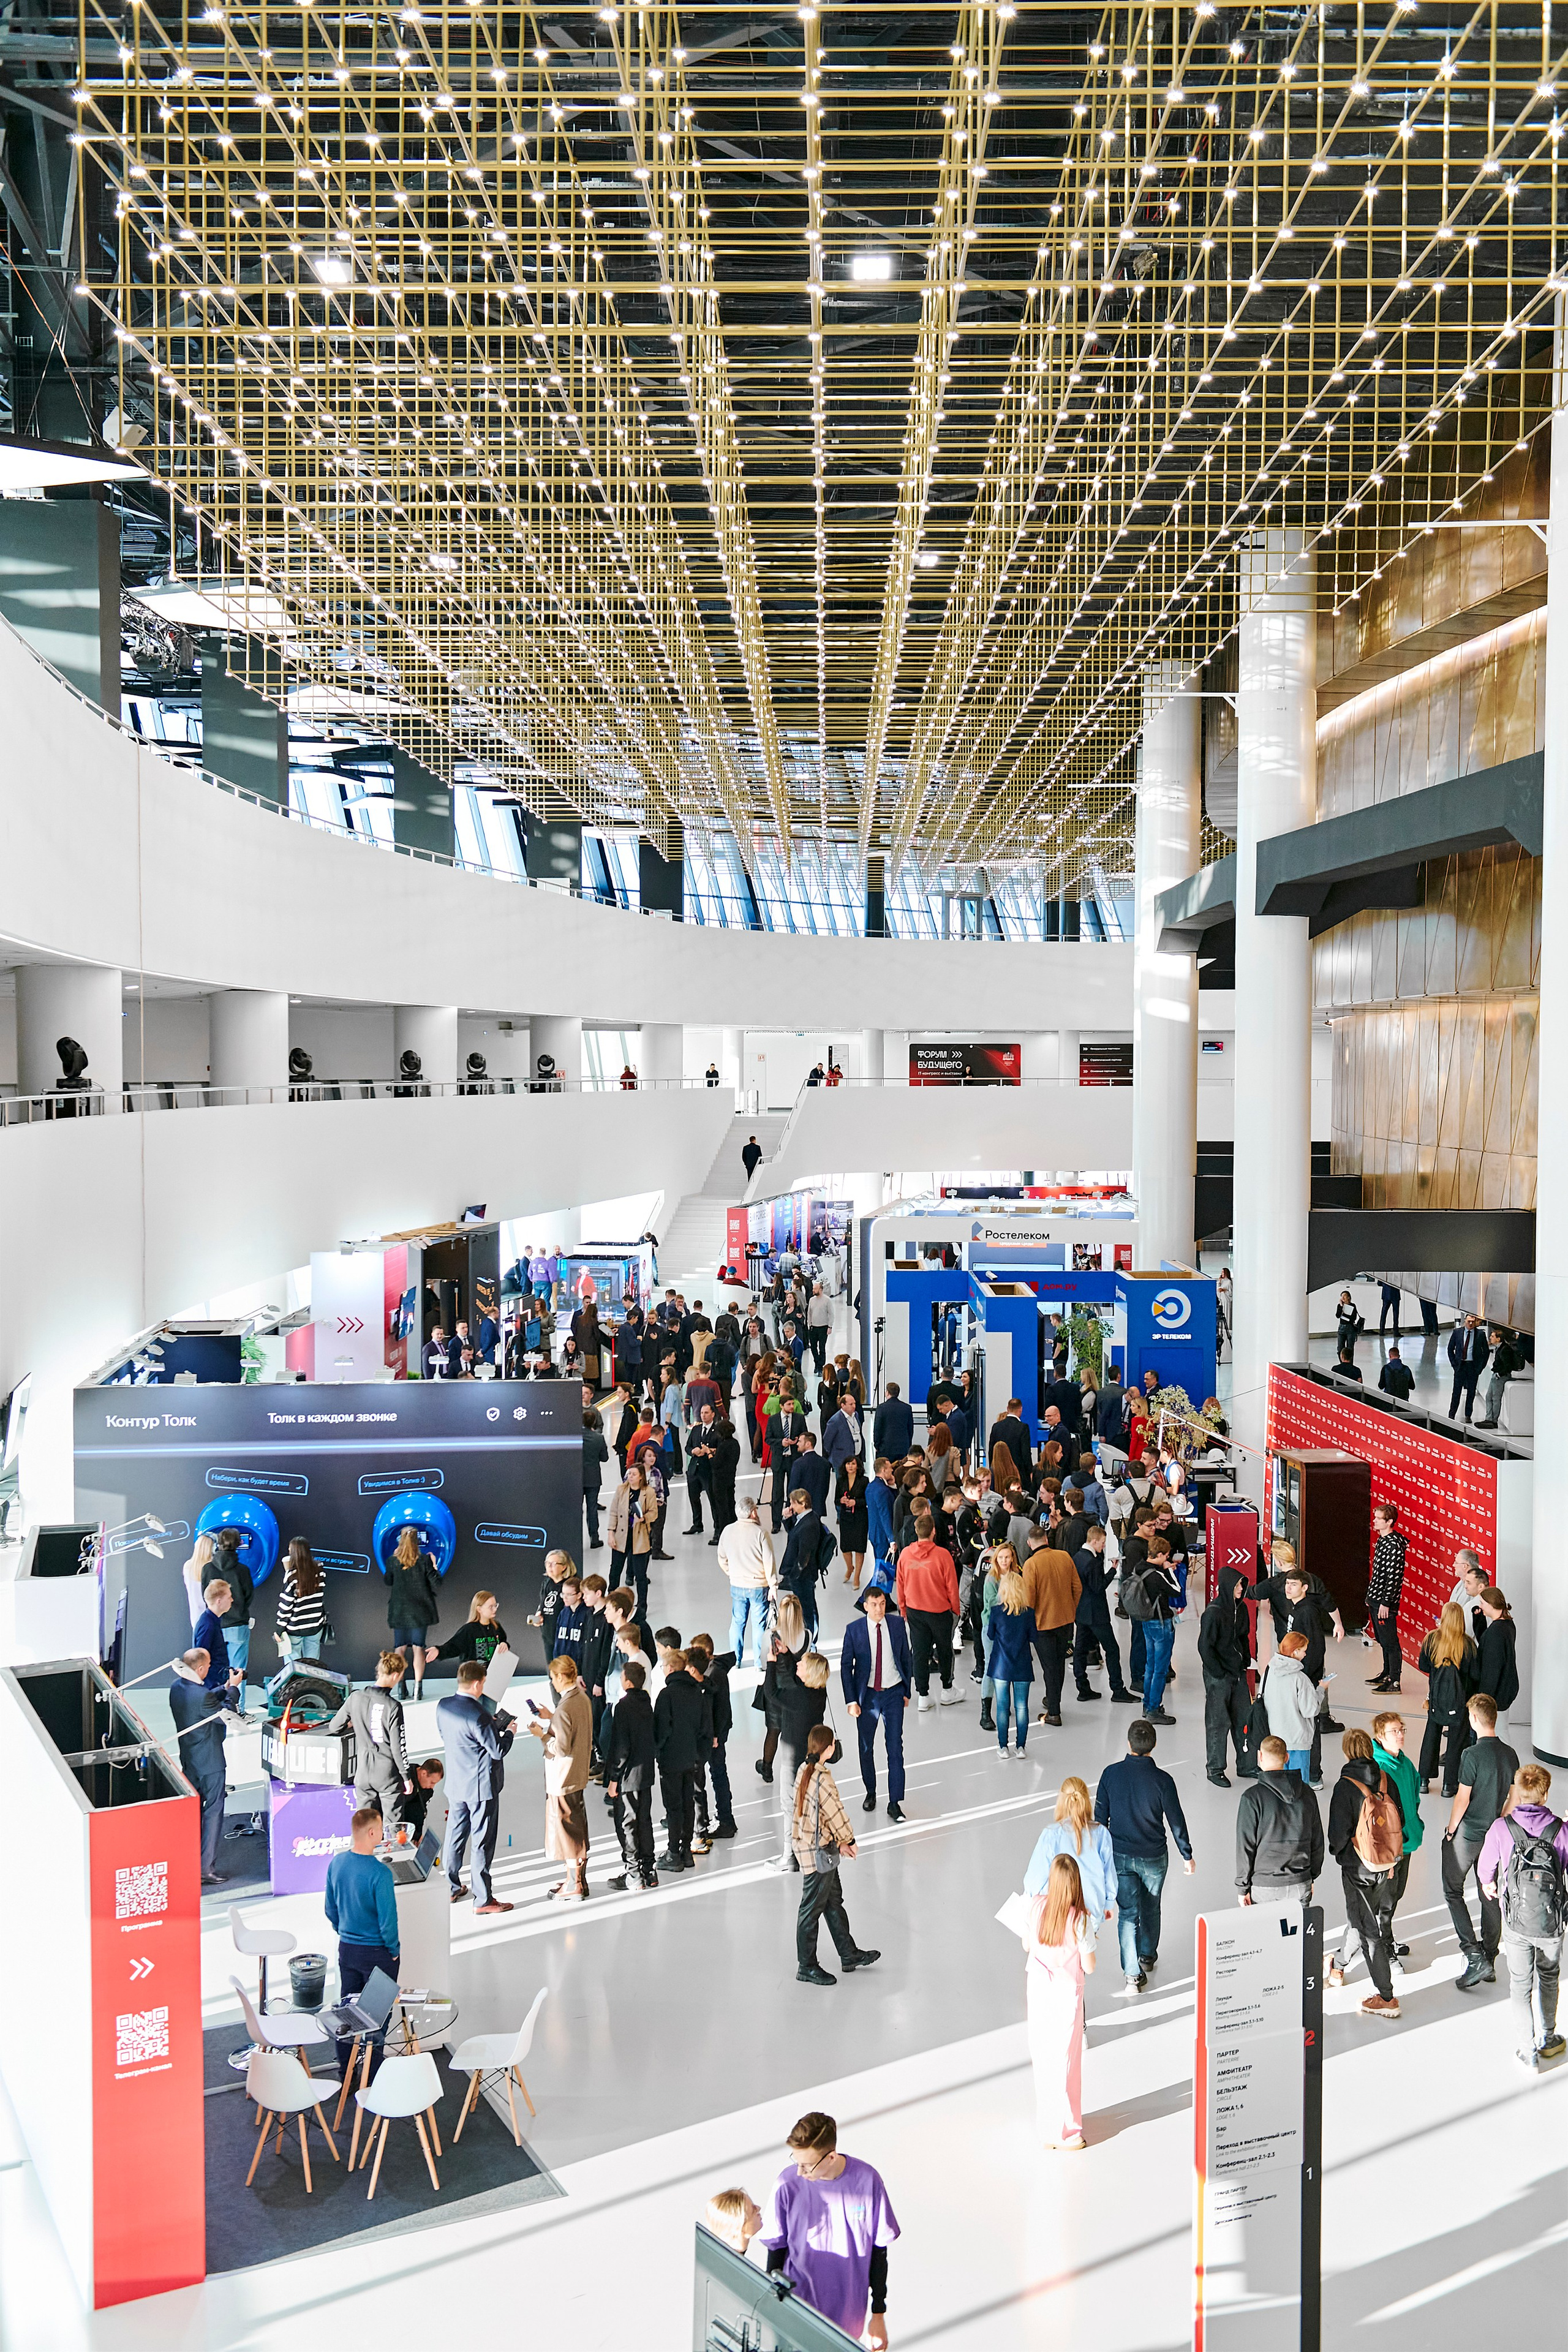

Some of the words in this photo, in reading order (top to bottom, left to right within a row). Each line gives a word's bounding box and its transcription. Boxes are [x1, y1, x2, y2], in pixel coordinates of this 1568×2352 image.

[918, 1061, 962, 1069] БУДУЩЕГО
[985, 1229, 1050, 1240] Ростелеком
[105, 1415, 160, 1430] Контур
[161, 1414, 197, 1427] Толк
[267, 1412, 296, 1423] Толк
[307, 1414, 354, 1424] каждом
[355, 1412, 398, 1422] звонке
[211, 1474, 237, 1482] Набери,
[1306, 1923, 1315, 1936] 4
[1216, 1952, 1249, 1961] Конференц-зал
[1306, 1977, 1314, 1990] 3
[1216, 2007, 1247, 2016] Переговорная
[1215, 2021, 1248, 2030] Конференц-зал
[1305, 2030, 1315, 2046] 2
[1216, 2049, 1239, 2058] ПАРТЕР
[1217, 2065, 1253, 2076] АМФИТЕАТР
[1216, 2073, 1251, 2083] AMPHITHEATER
[1216, 2084, 1248, 2095] БЕЛЬЭТАЖ
[1216, 2105, 1235, 2114] ЛОЖА
[1216, 2141, 1238, 2151] Переход
[1244, 2133, 1280, 2144] выставочный
[1280, 2129, 1297, 2138] центр
[1216, 2156, 1257, 2169] Конференц-зал
[1258, 2152, 1275, 2161] 2.1-2.3
[1216, 2167, 1238, 2176] Conference
[1306, 2166, 1313, 2180] 1
